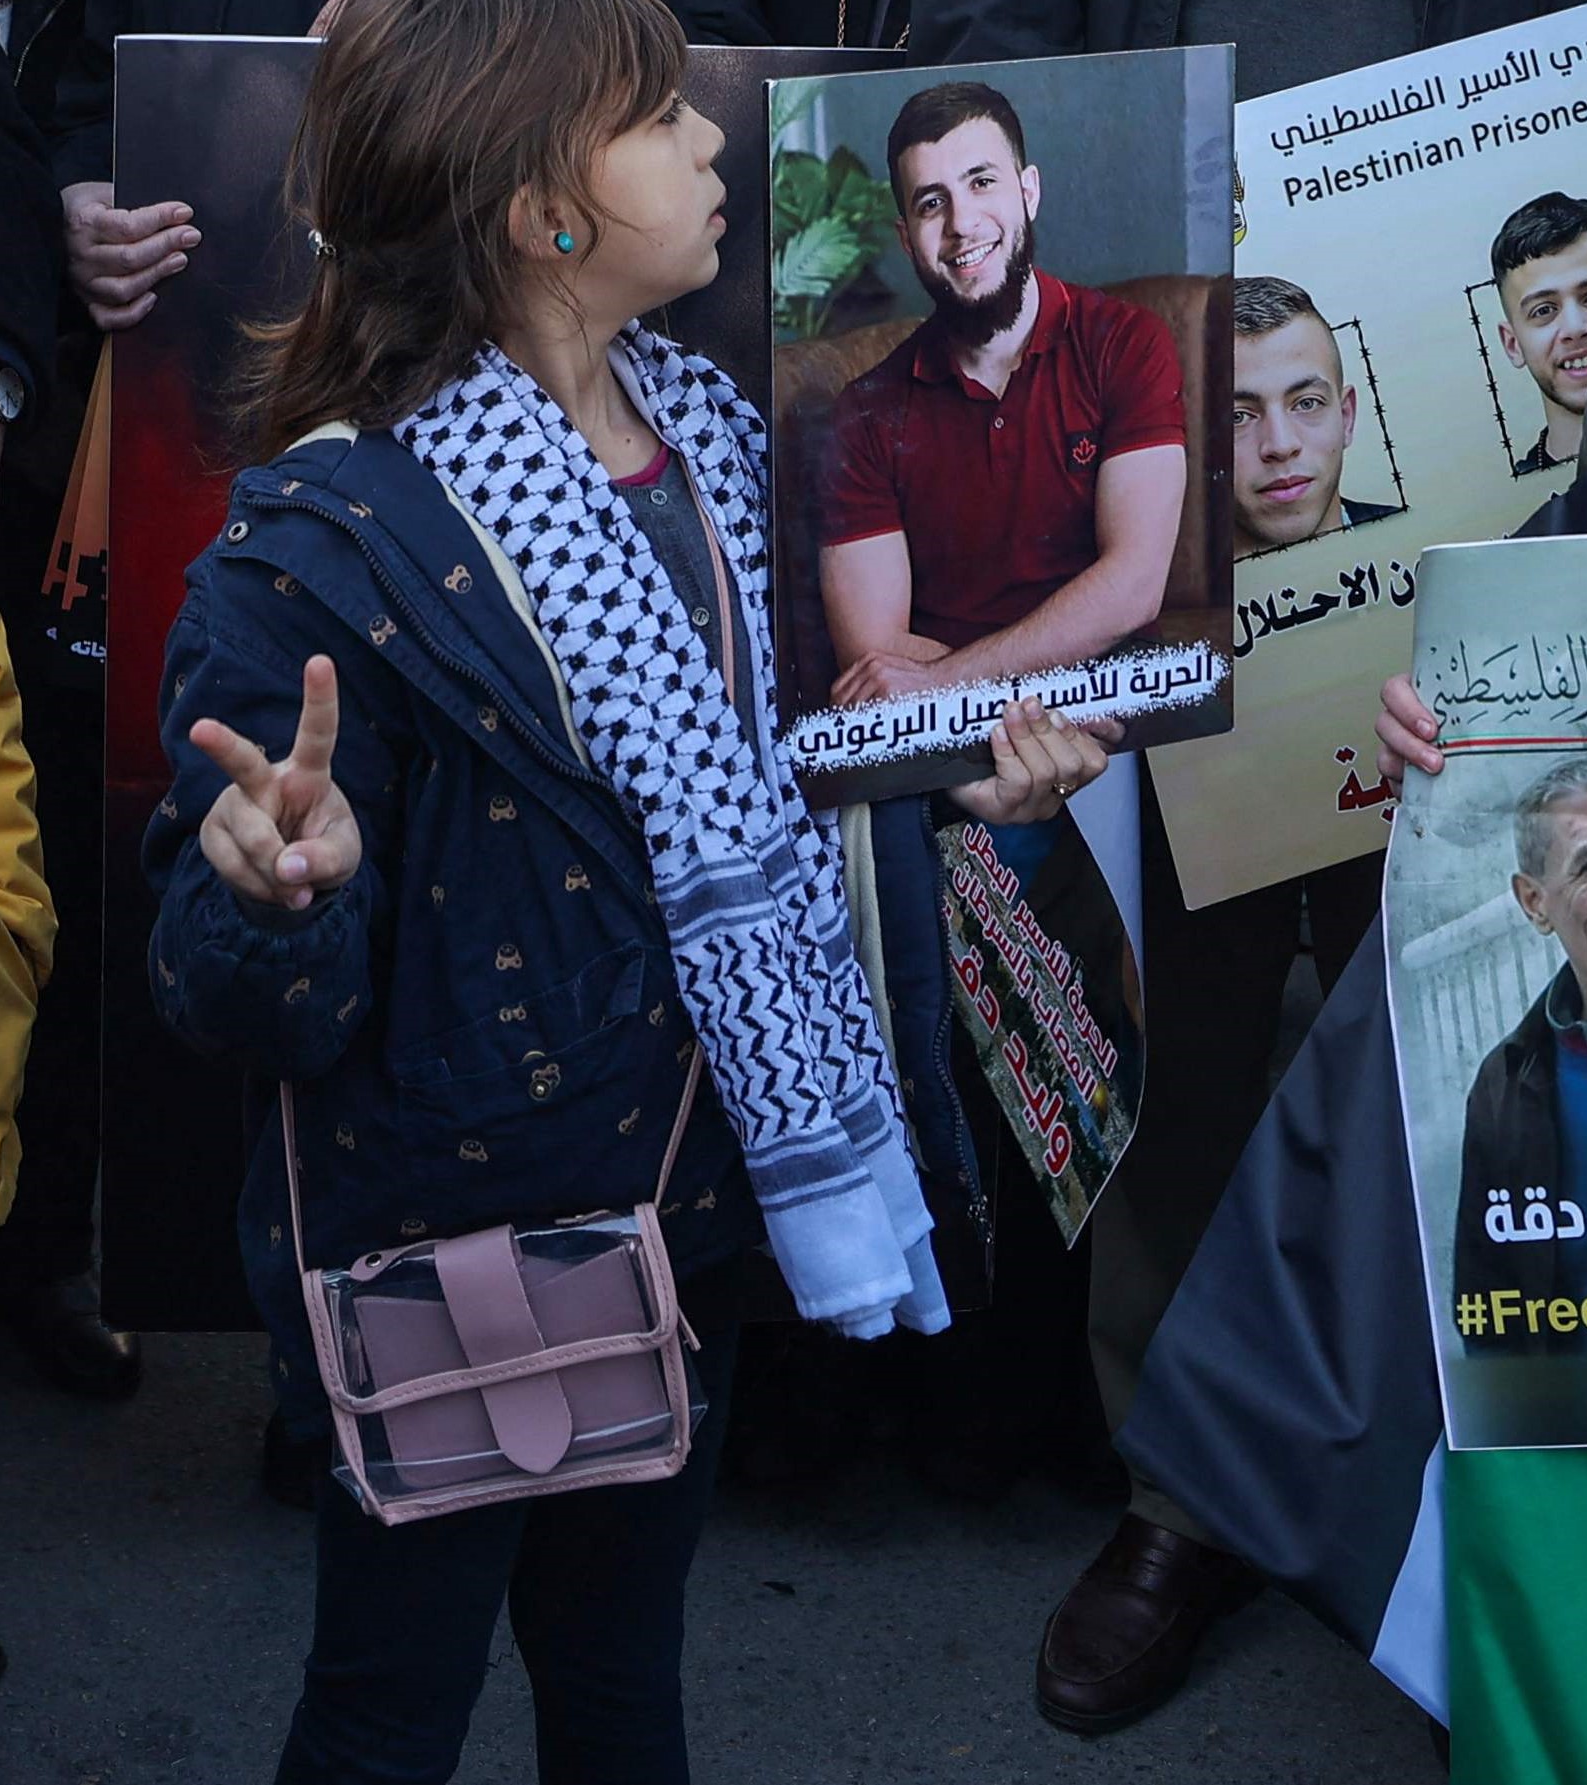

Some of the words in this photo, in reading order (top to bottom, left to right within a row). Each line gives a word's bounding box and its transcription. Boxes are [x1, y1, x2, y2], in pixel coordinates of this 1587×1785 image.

[1269, 75, 1446, 157] الفلسطيني
[1455, 48, 1541, 110] الأسير
[1283, 135, 1465, 208] Palestinian
[1232, 560, 1381, 658] الاحتلال
[1129, 654, 1214, 701] الحرية
[797, 702, 937, 765] البرغوثي
[963, 822, 1021, 904] البطل
[1011, 899, 1073, 991] للأسير
[950, 945, 1001, 1034] دق
[1066, 980, 1118, 1079] الحرية
[1031, 988, 1099, 1105] المصاب
[1001, 1030, 1073, 1178] وليد
